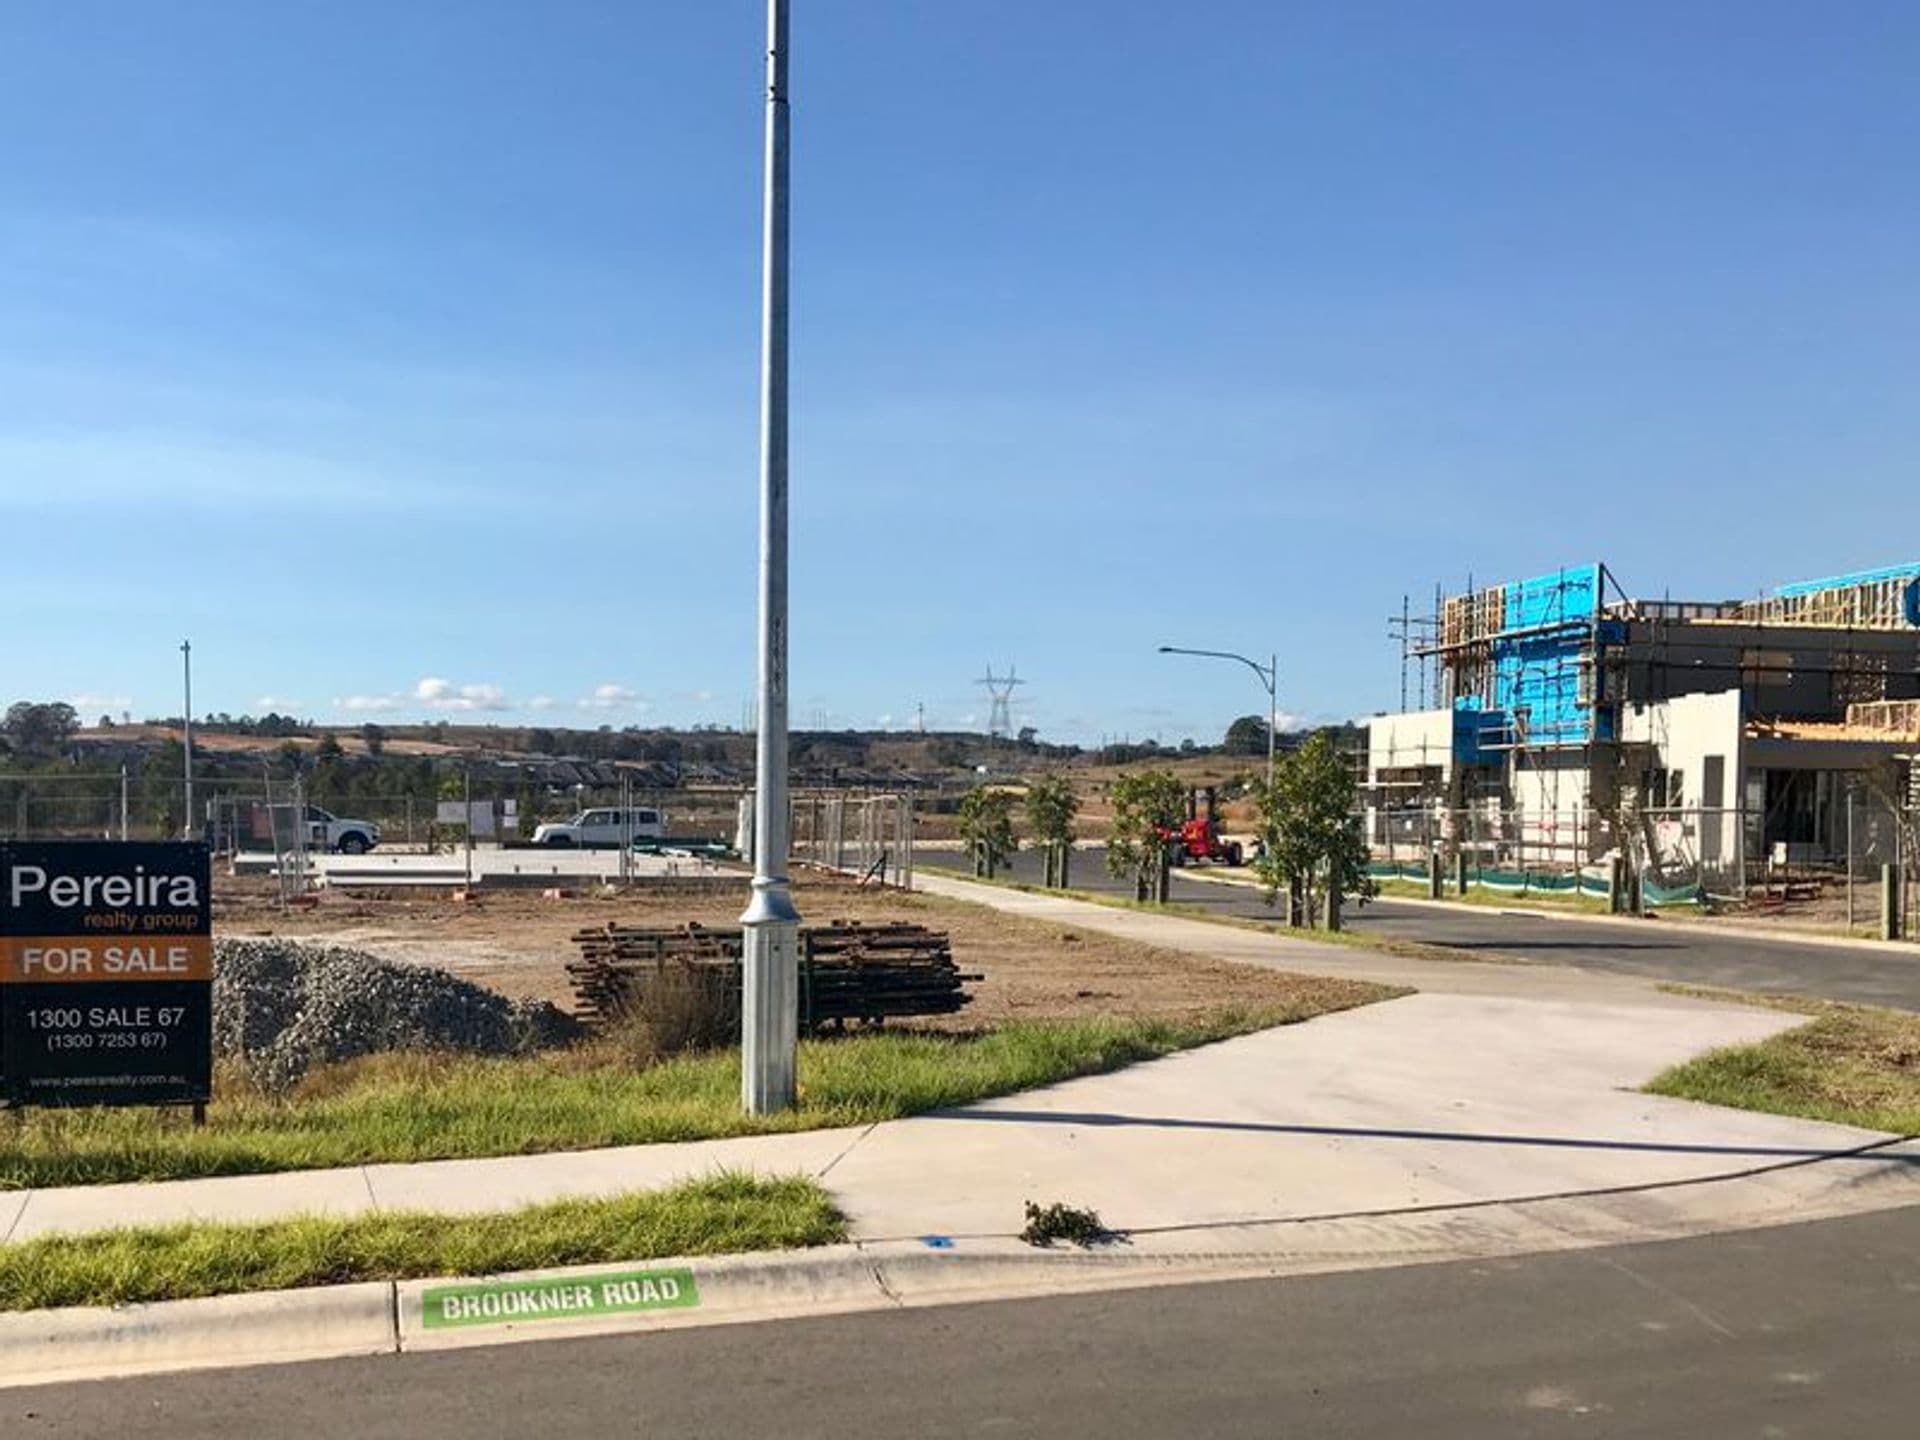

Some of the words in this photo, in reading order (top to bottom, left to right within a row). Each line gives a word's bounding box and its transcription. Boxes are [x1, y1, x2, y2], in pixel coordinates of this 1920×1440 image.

[11, 865, 199, 908] Pereira
[83, 911, 138, 931] realty
[143, 913, 199, 930] group
[23, 948, 93, 974] FOR
[103, 947, 189, 973] SALE
[27, 1008, 82, 1029] 1300
[88, 1007, 151, 1027] SALE
[157, 1007, 186, 1026] 67
[48, 1033, 94, 1051] (1300
[140, 1032, 168, 1049] 67)
[442, 1284, 594, 1320] BROOKNER
[603, 1277, 680, 1306] ROAD
